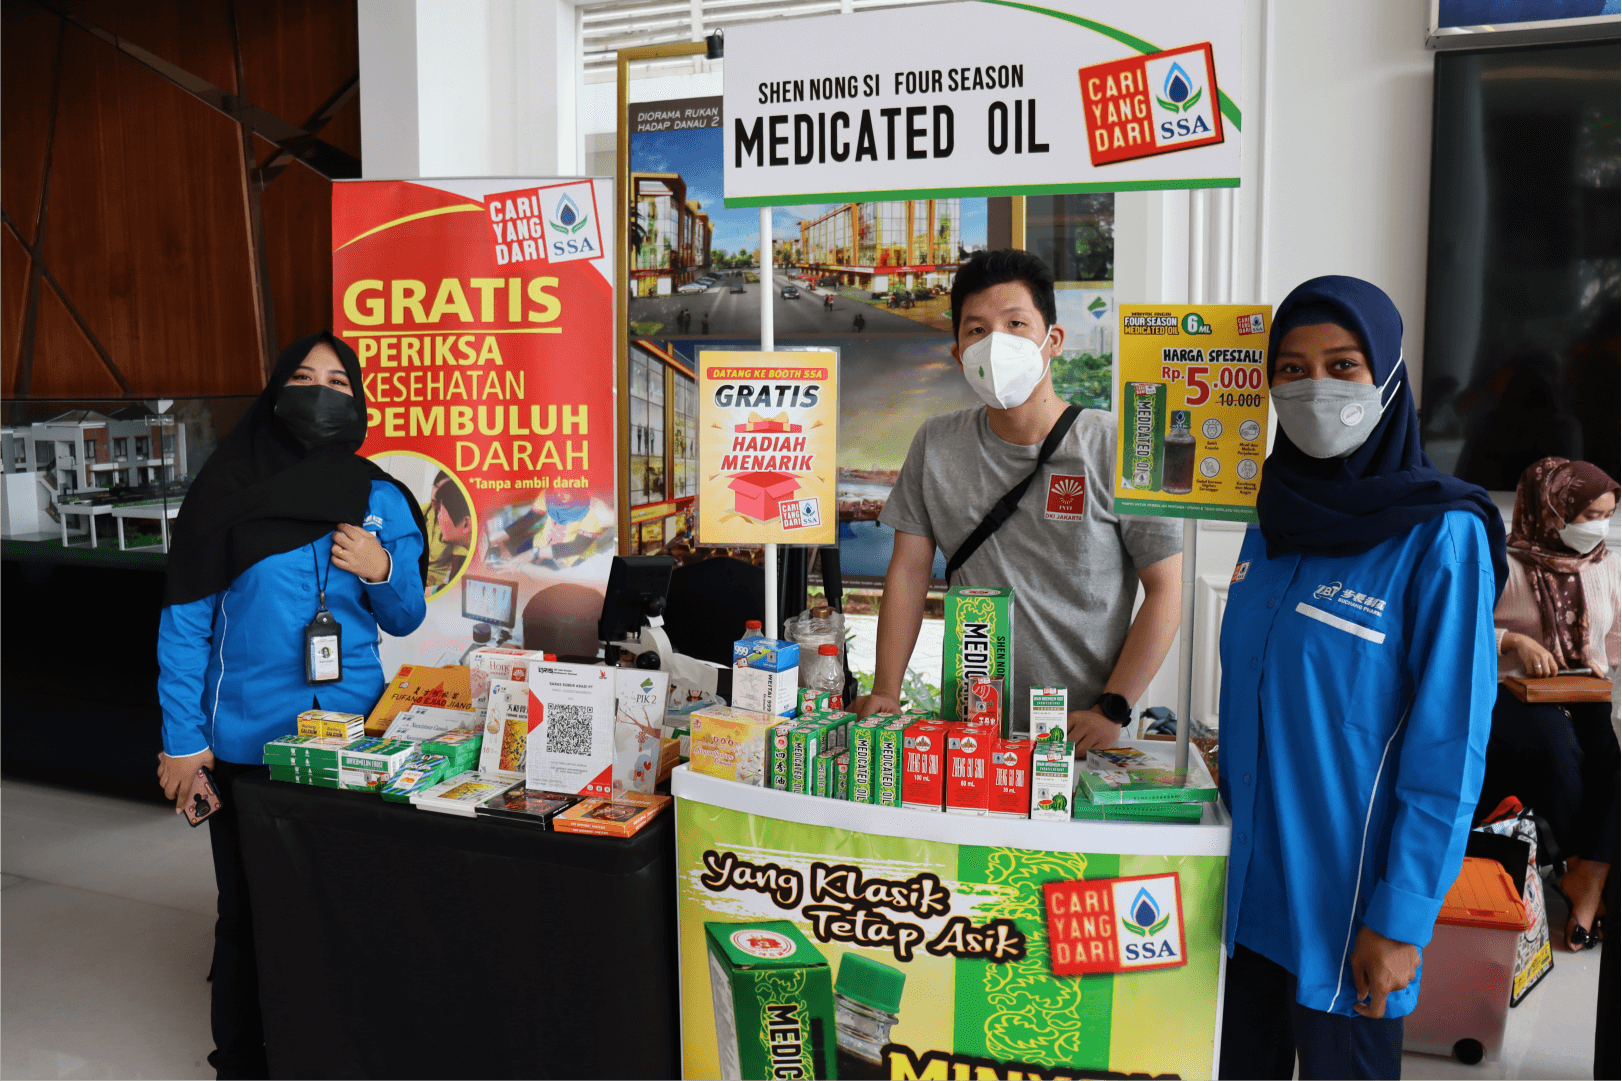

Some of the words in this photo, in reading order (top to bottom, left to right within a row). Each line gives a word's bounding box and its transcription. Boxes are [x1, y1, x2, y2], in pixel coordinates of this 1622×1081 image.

[758, 80, 807, 104] SHEN
[809, 77, 859, 102] NONG
[862, 76, 881, 98] SI
[894, 71, 943, 95] FOUR
[947, 64, 1024, 93] SEASON
[1088, 68, 1144, 101] CARI
[637, 110, 681, 121] DIORAMA
[684, 107, 719, 118] RUKAN
[1091, 95, 1147, 126] YANG
[637, 121, 671, 132] HADAP
[674, 119, 707, 130] DANAU
[711, 116, 720, 127] 2
[735, 104, 956, 169] MEDICATED
[986, 98, 1050, 156] OIL
[1095, 120, 1151, 152] DARI
[1160, 114, 1211, 139] SSA
[489, 195, 539, 222] CARI
[492, 217, 542, 244] YANG
[495, 238, 546, 265] DARI
[553, 237, 596, 257] SSA
[343, 276, 562, 326] GRATIS
[1124, 316, 1145, 326] FOUR
[1146, 316, 1177, 327] SEASON
[1124, 325, 1166, 335] MEDICATED
[1167, 326, 1179, 336] OIL
[1187, 315, 1198, 333] 6
[1198, 326, 1212, 334] ML
[359, 335, 504, 368] PERIKSA
[1163, 348, 1204, 363] HARGA
[1208, 349, 1263, 364] SPESIAL!
[713, 369, 751, 378] DATANG
[754, 369, 766, 378] KE
[769, 369, 801, 379] BOOTH
[803, 370, 823, 379] SSA
[1162, 366, 1185, 383] Rp.
[361, 370, 525, 403] KESEHATAN
[714, 384, 821, 408] GRATIS
[1219, 392, 1261, 408] 10.000
[365, 404, 589, 438] PEMBULUH
[1136, 401, 1152, 457] MEDICATED
[732, 436, 806, 452] HADIAH
[456, 441, 589, 472] DARAH
[720, 455, 814, 471] MENARIK
[1136, 462, 1149, 472] OI
[514, 476, 550, 489] ambil
[552, 476, 589, 489] darah
[782, 503, 799, 513] CARI
[783, 510, 800, 520] YANG
[784, 518, 801, 527] DARI
[803, 517, 817, 525] SSA
[734, 645, 749, 656] 999
[996, 636, 1005, 660] SHEN
[391, 693, 423, 704] FUFANG
[423, 697, 447, 707] EJIAO
[447, 700, 472, 710] JIANG
[636, 693, 650, 703] PIK
[651, 695, 657, 704] 2
[774, 751, 787, 785] 四季油
[793, 742, 803, 781] MEDICATED
[856, 738, 868, 785] MEDICATED
[882, 741, 894, 788] MEDICATED
[856, 788, 868, 801] OIL
[881, 791, 893, 804] OIL
[704, 859, 800, 905] Yang
[814, 866, 948, 914] Klasik
[1051, 890, 1110, 915] CARI
[805, 908, 921, 958] Tetap
[929, 921, 1023, 960] Asik
[1054, 914, 1112, 941] YANG
[1056, 939, 1115, 965] DARI
[1125, 939, 1178, 961] SSA
